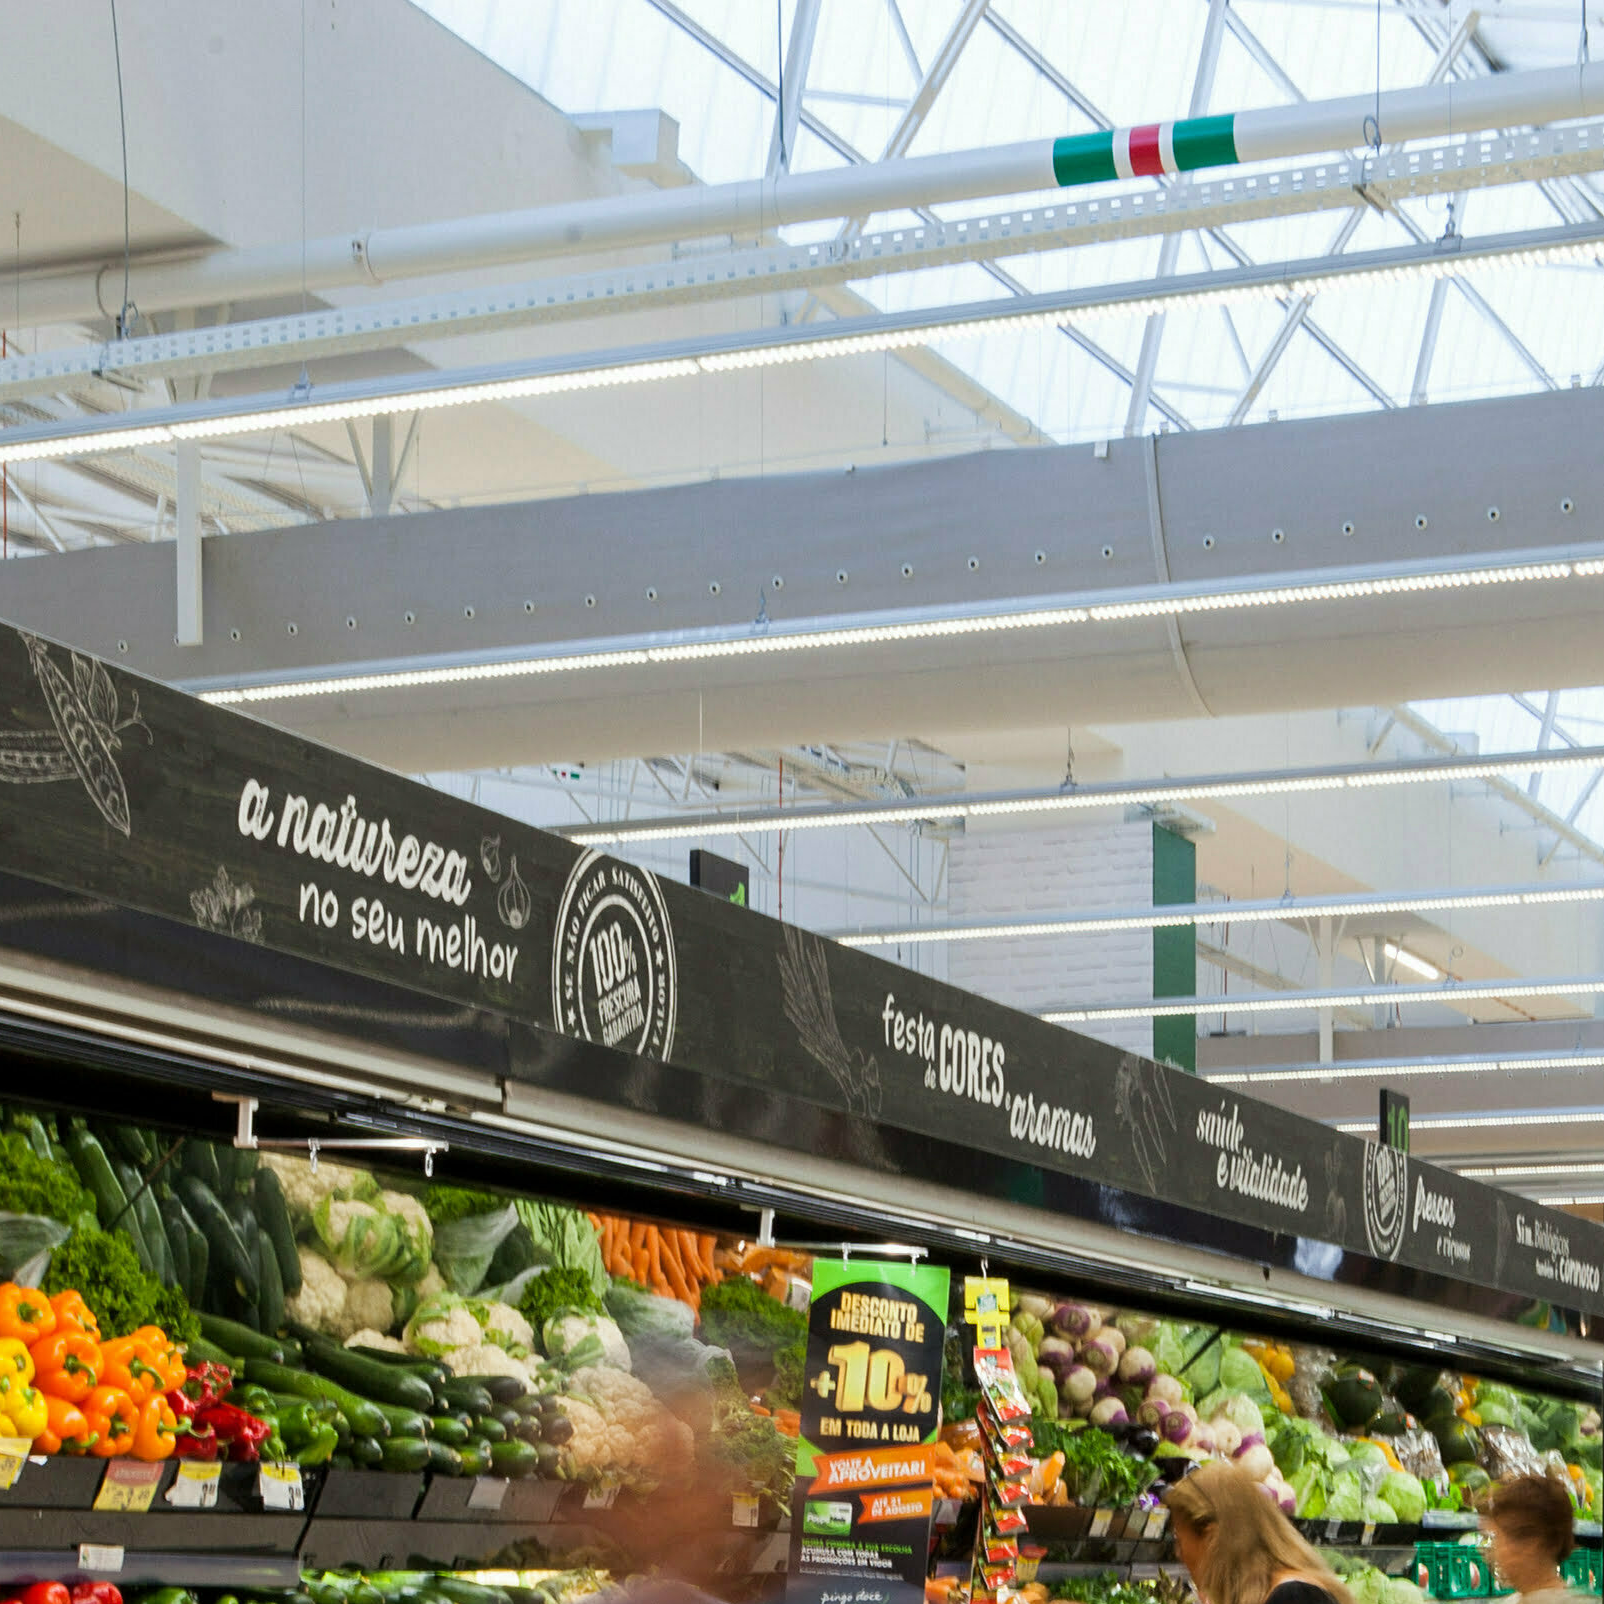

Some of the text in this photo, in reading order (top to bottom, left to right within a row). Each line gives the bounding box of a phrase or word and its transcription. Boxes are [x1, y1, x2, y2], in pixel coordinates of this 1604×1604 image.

[237, 778, 472, 906] a natureza
[299, 881, 519, 984] no seu melhor
[577, 869, 607, 918] FICAR
[612, 865, 660, 943] SATISFEITO
[589, 921, 638, 997] 100%
[598, 975, 642, 1030] FRESCURA
[882, 992, 935, 1062] festa
[924, 1023, 1005, 1108] de CORES
[1009, 1091, 1097, 1160] aromas
[1196, 1098, 1244, 1154] saúde
[1387, 1104, 1409, 1153] 10
[1216, 1144, 1309, 1212] e vitalidade
[830, 1308, 925, 1343] IMEDIATO DE
[841, 1291, 918, 1323] DESCONTO
[820, 1416, 920, 1443] EM TODA A LOJA
